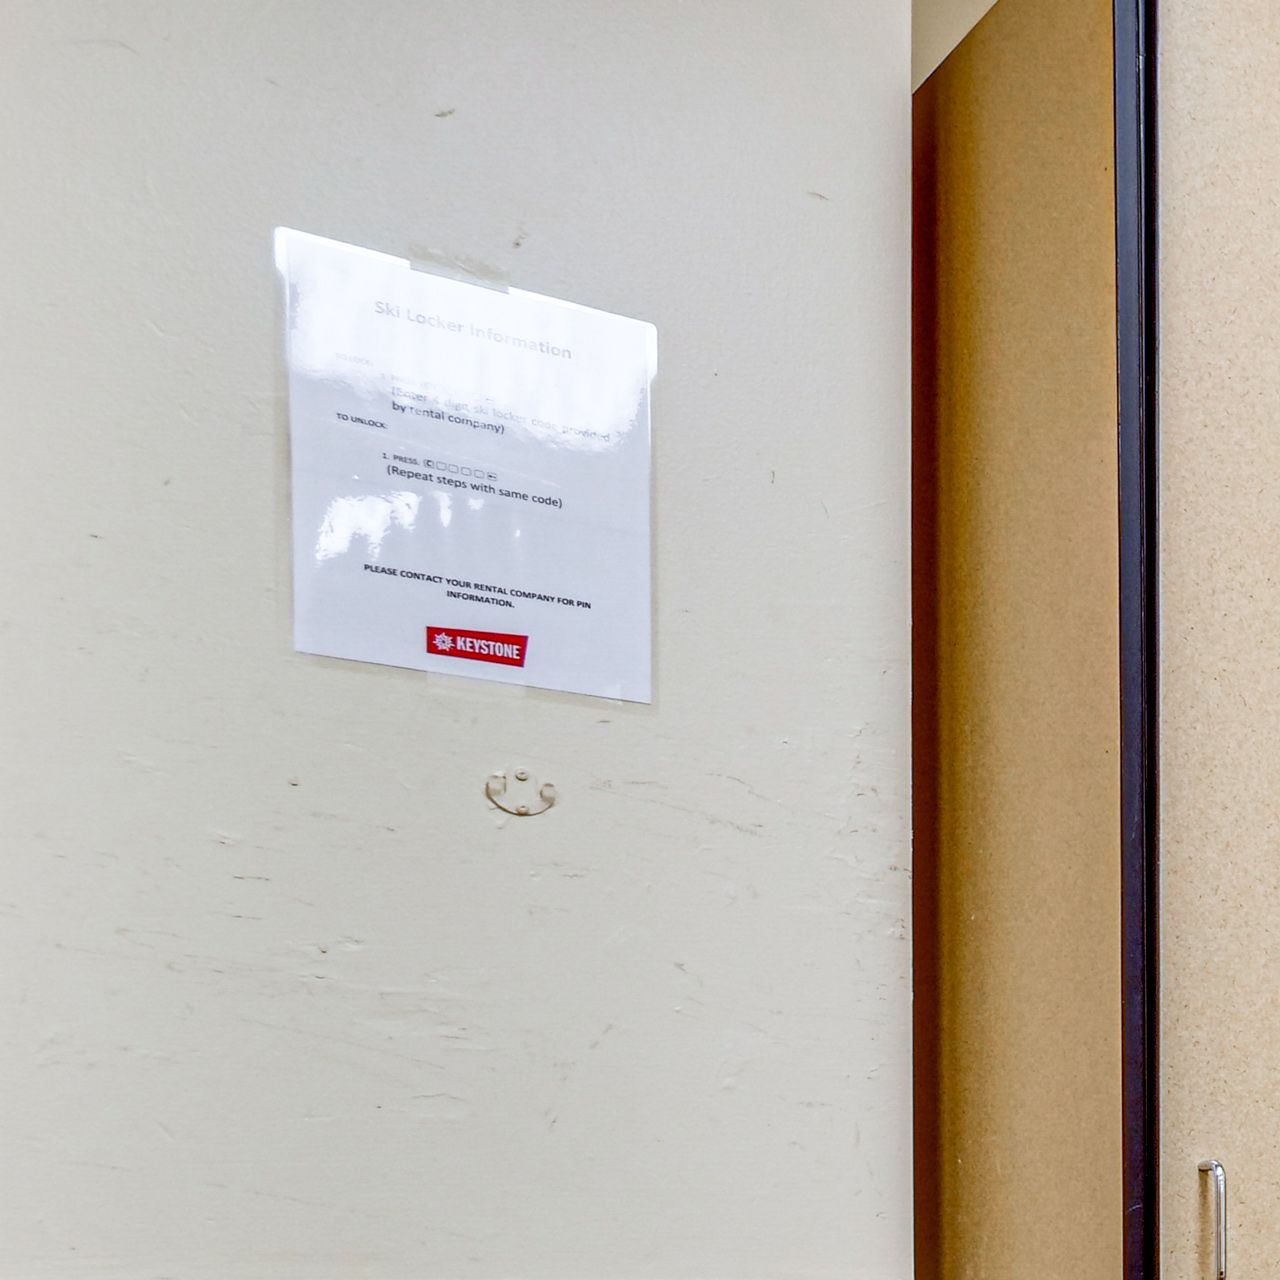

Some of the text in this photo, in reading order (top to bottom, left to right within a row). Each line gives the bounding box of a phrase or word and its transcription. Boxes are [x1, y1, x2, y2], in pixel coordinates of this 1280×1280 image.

[375, 301, 571, 359] Ski Locker Information
[336, 412, 349, 421] TO
[391, 401, 505, 434] by rental company)
[387, 464, 563, 510] (Repeat steps with same code)
[364, 564, 592, 610] PLEASE CONTACT YOUR RENTAL COMPANY FOR PIN
[446, 590, 515, 609] INFORMATION.
[456, 636, 521, 661] KEYSTONE
